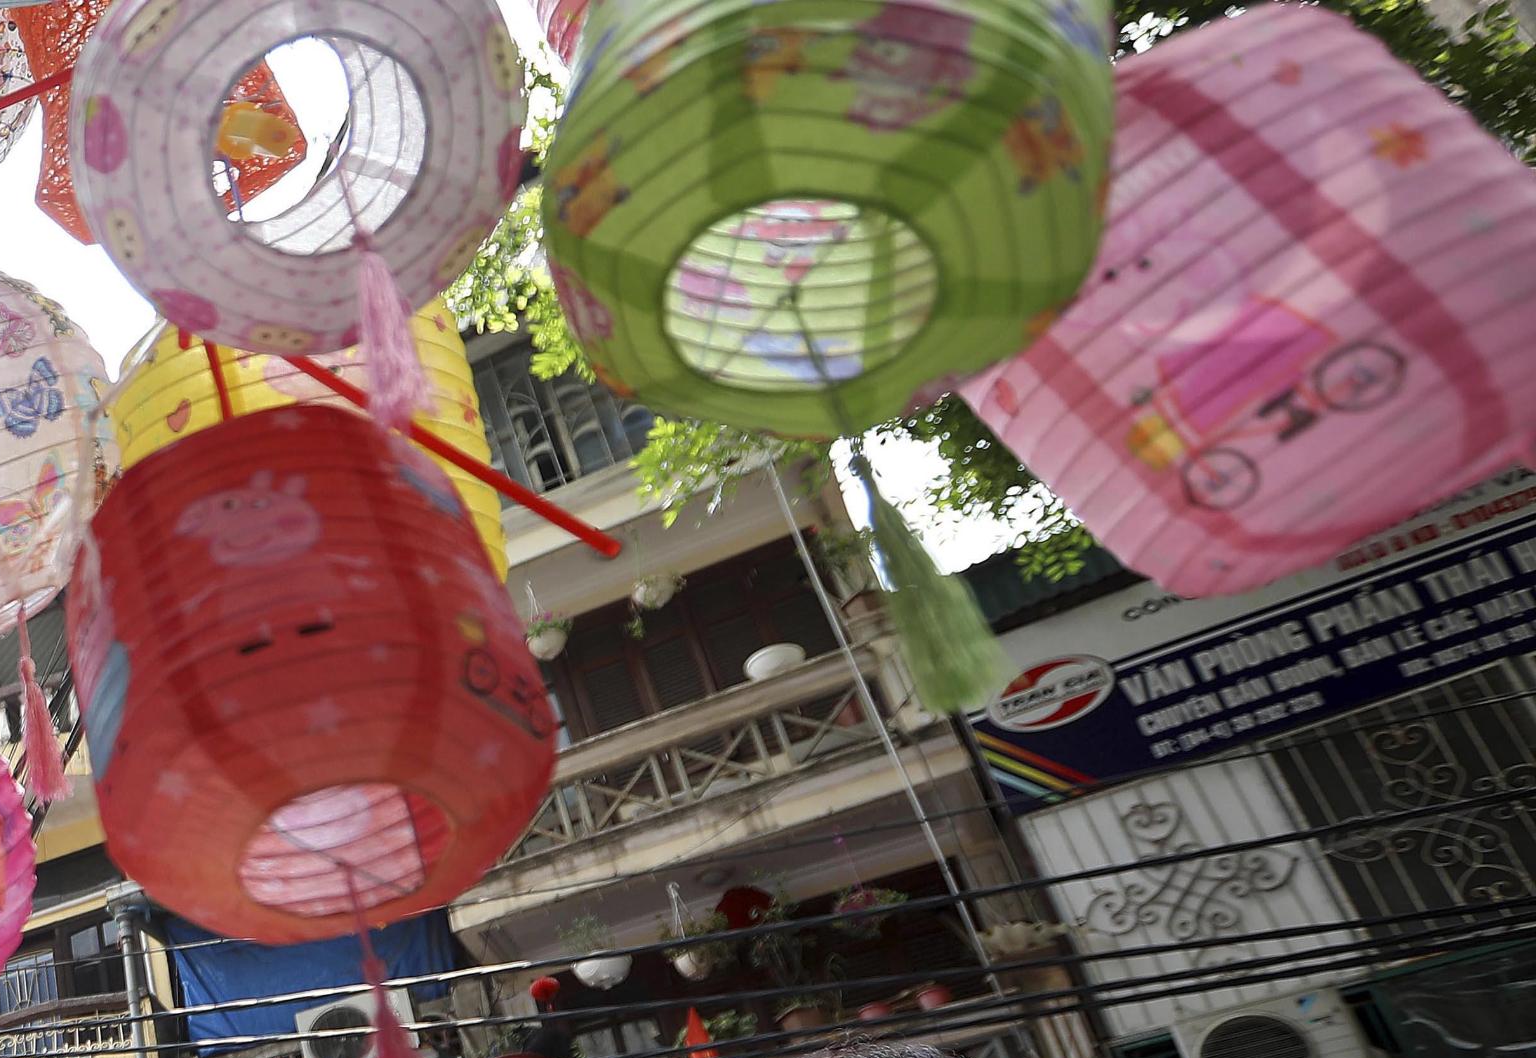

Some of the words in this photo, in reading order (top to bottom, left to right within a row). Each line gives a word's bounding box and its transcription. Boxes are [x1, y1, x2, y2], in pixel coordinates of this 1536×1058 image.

[1118, 657, 1195, 706] VĂN
[1190, 619, 1311, 682] PHÒNG
[1307, 581, 1425, 644] PHẨM
[1416, 549, 1515, 604] THÁI
[1136, 692, 1224, 737] CHUYÊN
[1218, 676, 1274, 710] BÁN
[1421, 608, 1480, 642] CÁC
